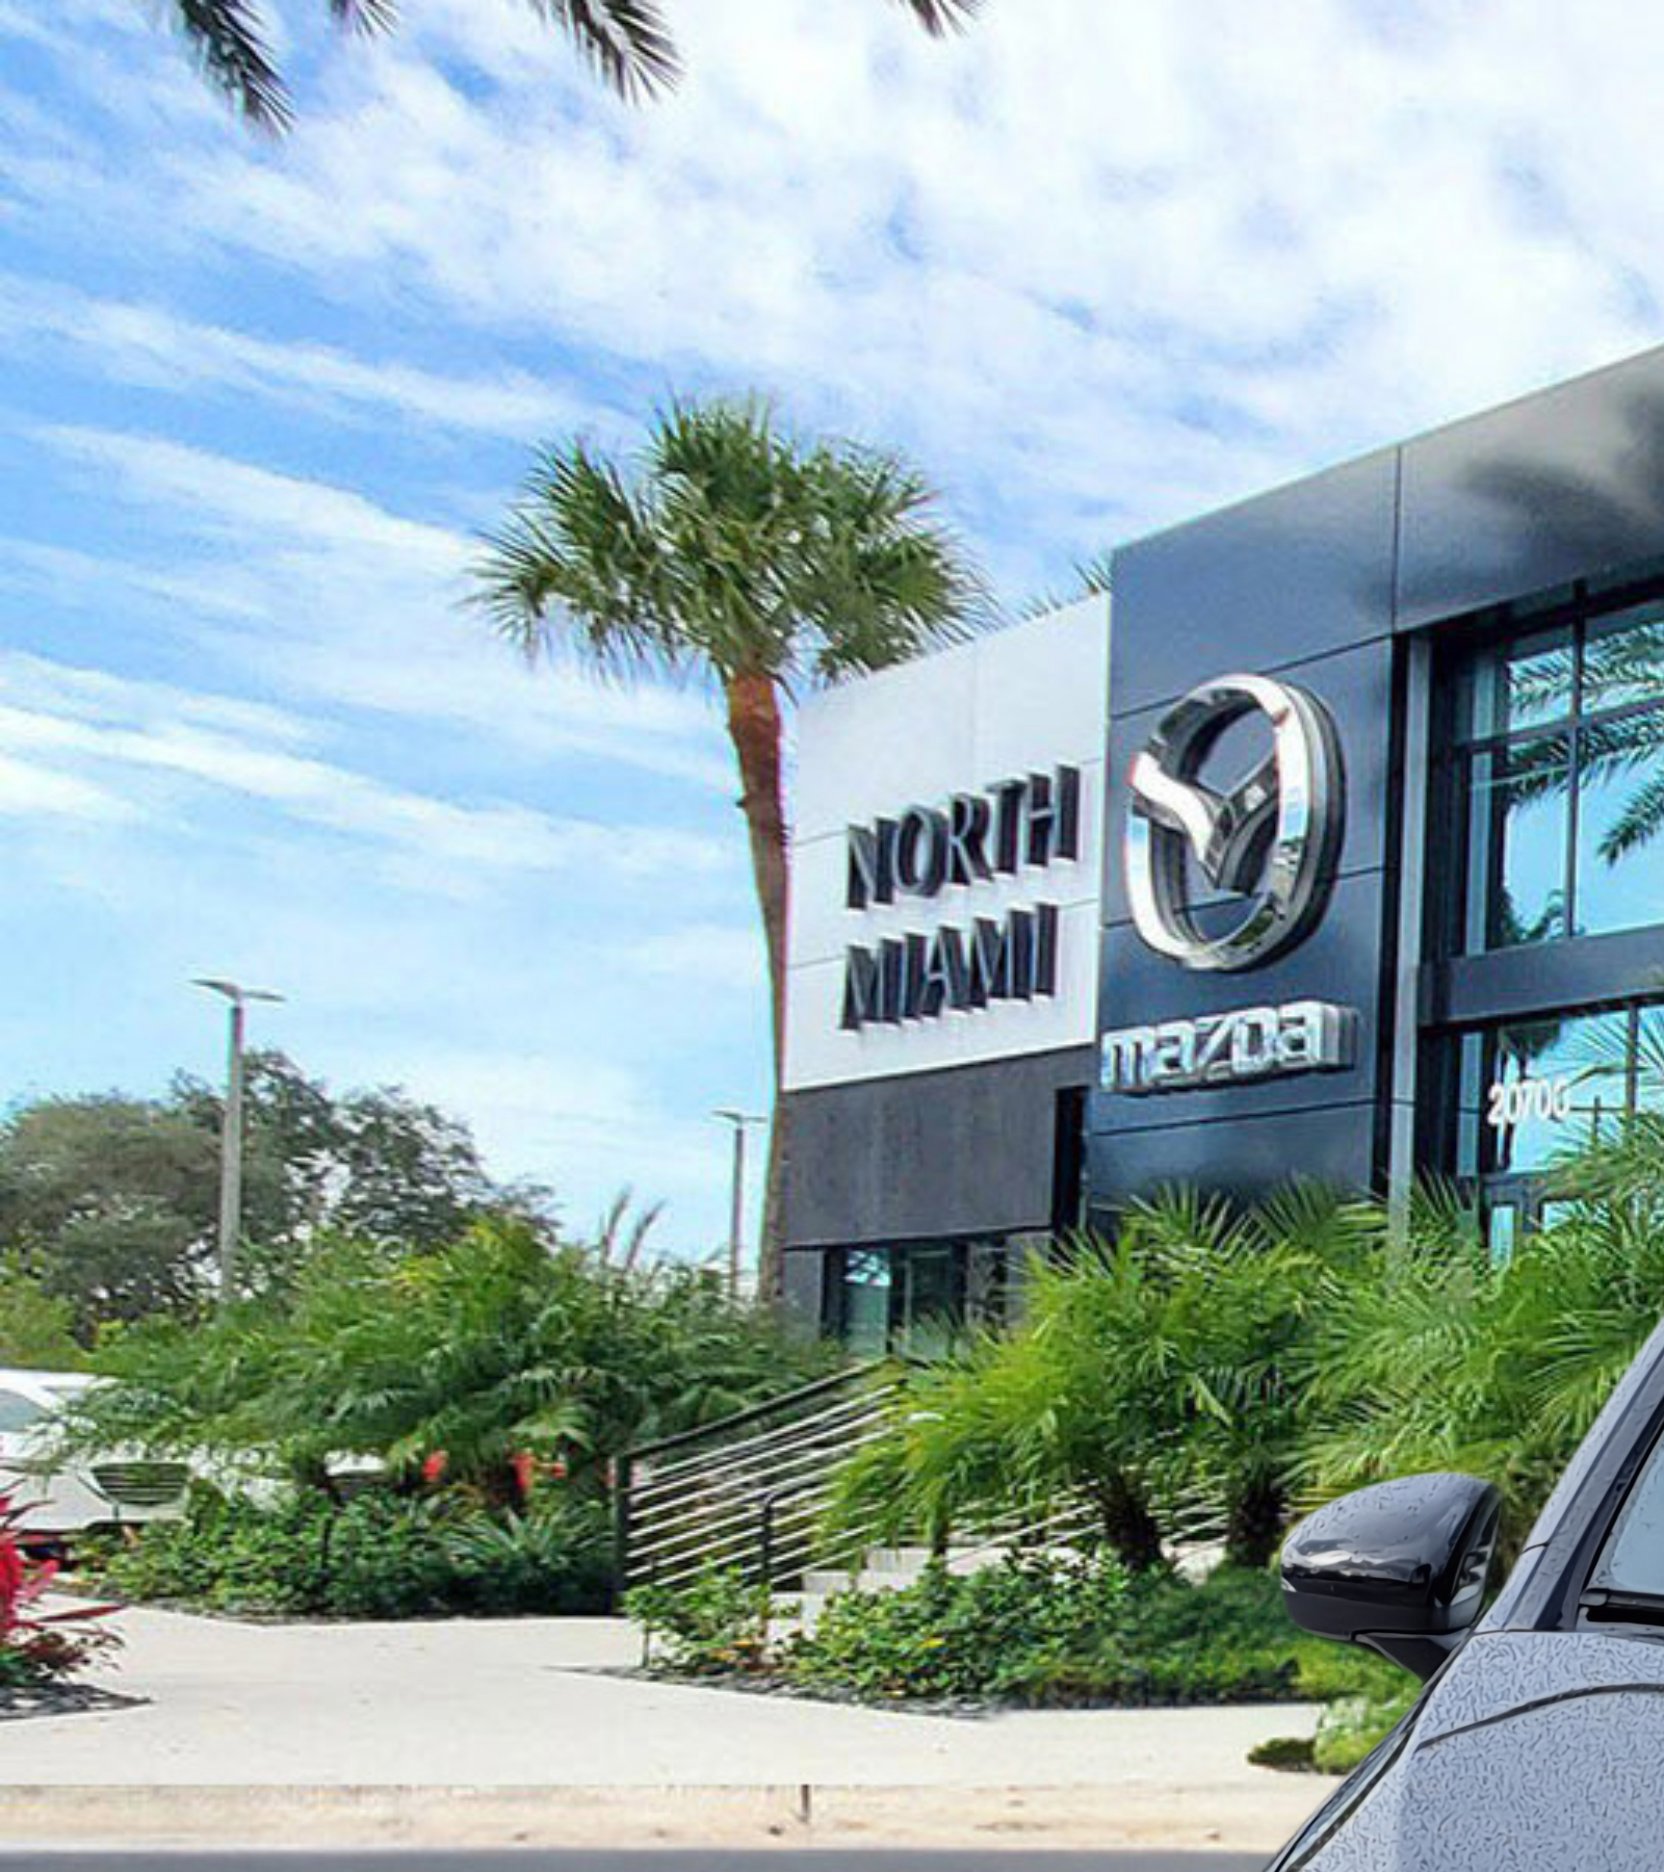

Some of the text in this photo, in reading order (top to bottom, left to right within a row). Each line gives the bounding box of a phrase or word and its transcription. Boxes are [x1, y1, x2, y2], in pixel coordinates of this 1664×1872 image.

[846, 764, 1080, 910] NORTH
[840, 903, 1058, 1029] MIAMI
[1099, 1000, 1345, 1092] mazda
